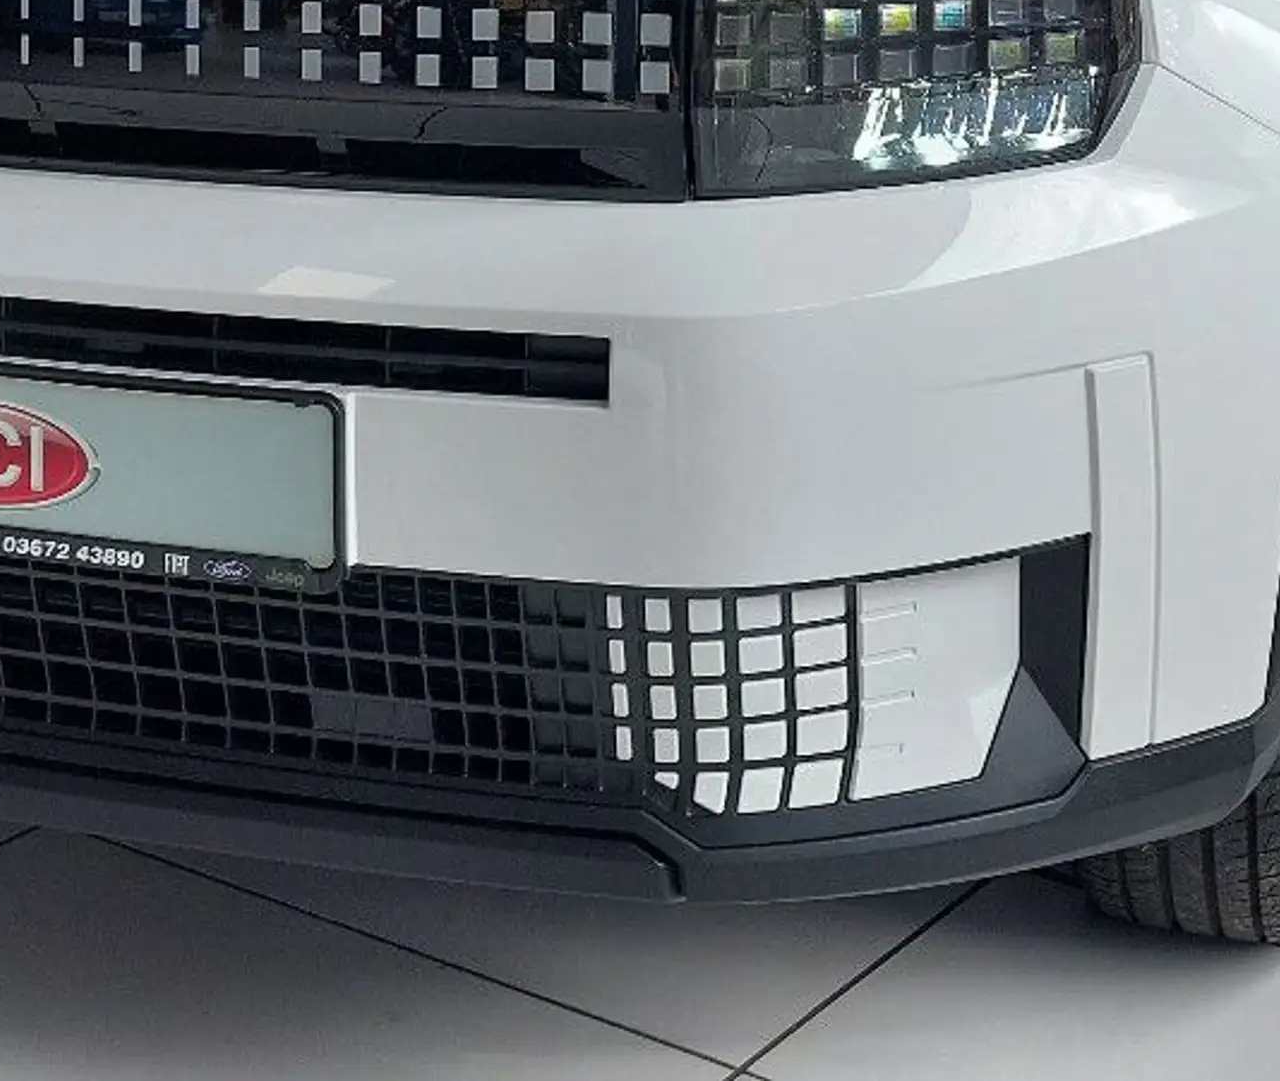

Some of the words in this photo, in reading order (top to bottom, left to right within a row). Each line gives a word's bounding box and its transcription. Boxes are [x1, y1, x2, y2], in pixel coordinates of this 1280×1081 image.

[2, 535, 71, 560] 03672
[76, 545, 145, 569] 43890
[209, 560, 246, 580] Ford
